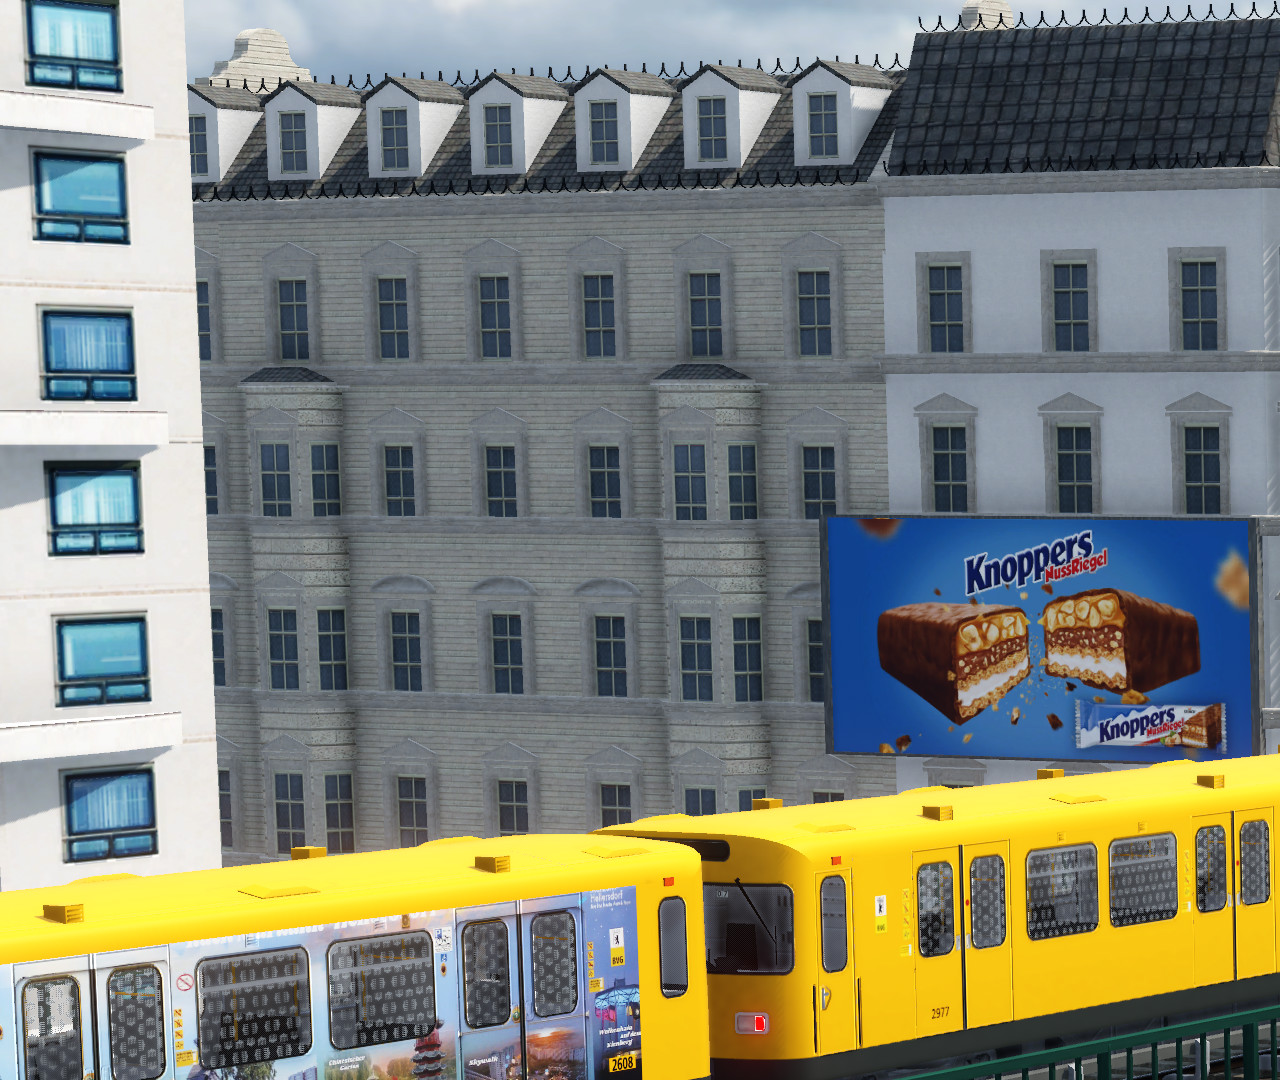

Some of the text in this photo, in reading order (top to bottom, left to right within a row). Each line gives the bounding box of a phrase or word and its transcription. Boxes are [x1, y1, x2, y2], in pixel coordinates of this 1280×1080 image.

[965, 530, 1093, 595] Knoppers
[1045, 549, 1108, 582] NussRiegel
[1099, 707, 1176, 743] Knoppers
[1146, 718, 1185, 737] NussRiegel
[612, 956, 624, 965] BVG
[931, 1006, 950, 1020] 2977
[612, 1055, 634, 1072] 2608
